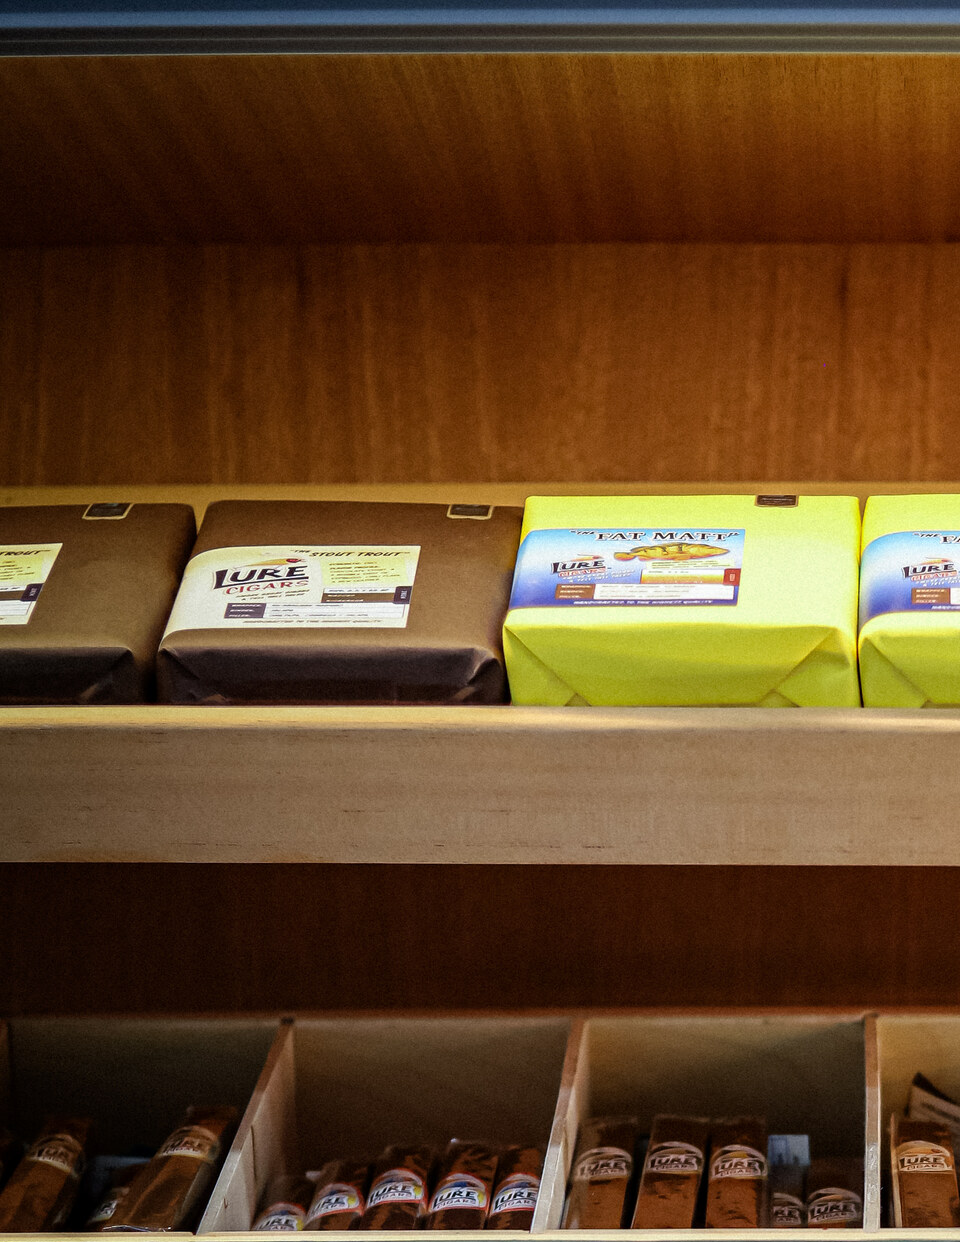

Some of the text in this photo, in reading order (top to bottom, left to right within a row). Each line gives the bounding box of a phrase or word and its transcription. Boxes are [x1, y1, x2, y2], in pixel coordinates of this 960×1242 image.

[595, 531, 646, 541] FAT
[652, 531, 739, 541] MATT"
[551, 560, 606, 575] LURE
[902, 563, 957, 579] LURE
[214, 565, 309, 590] LURE
[225, 580, 309, 595] CIGARS
